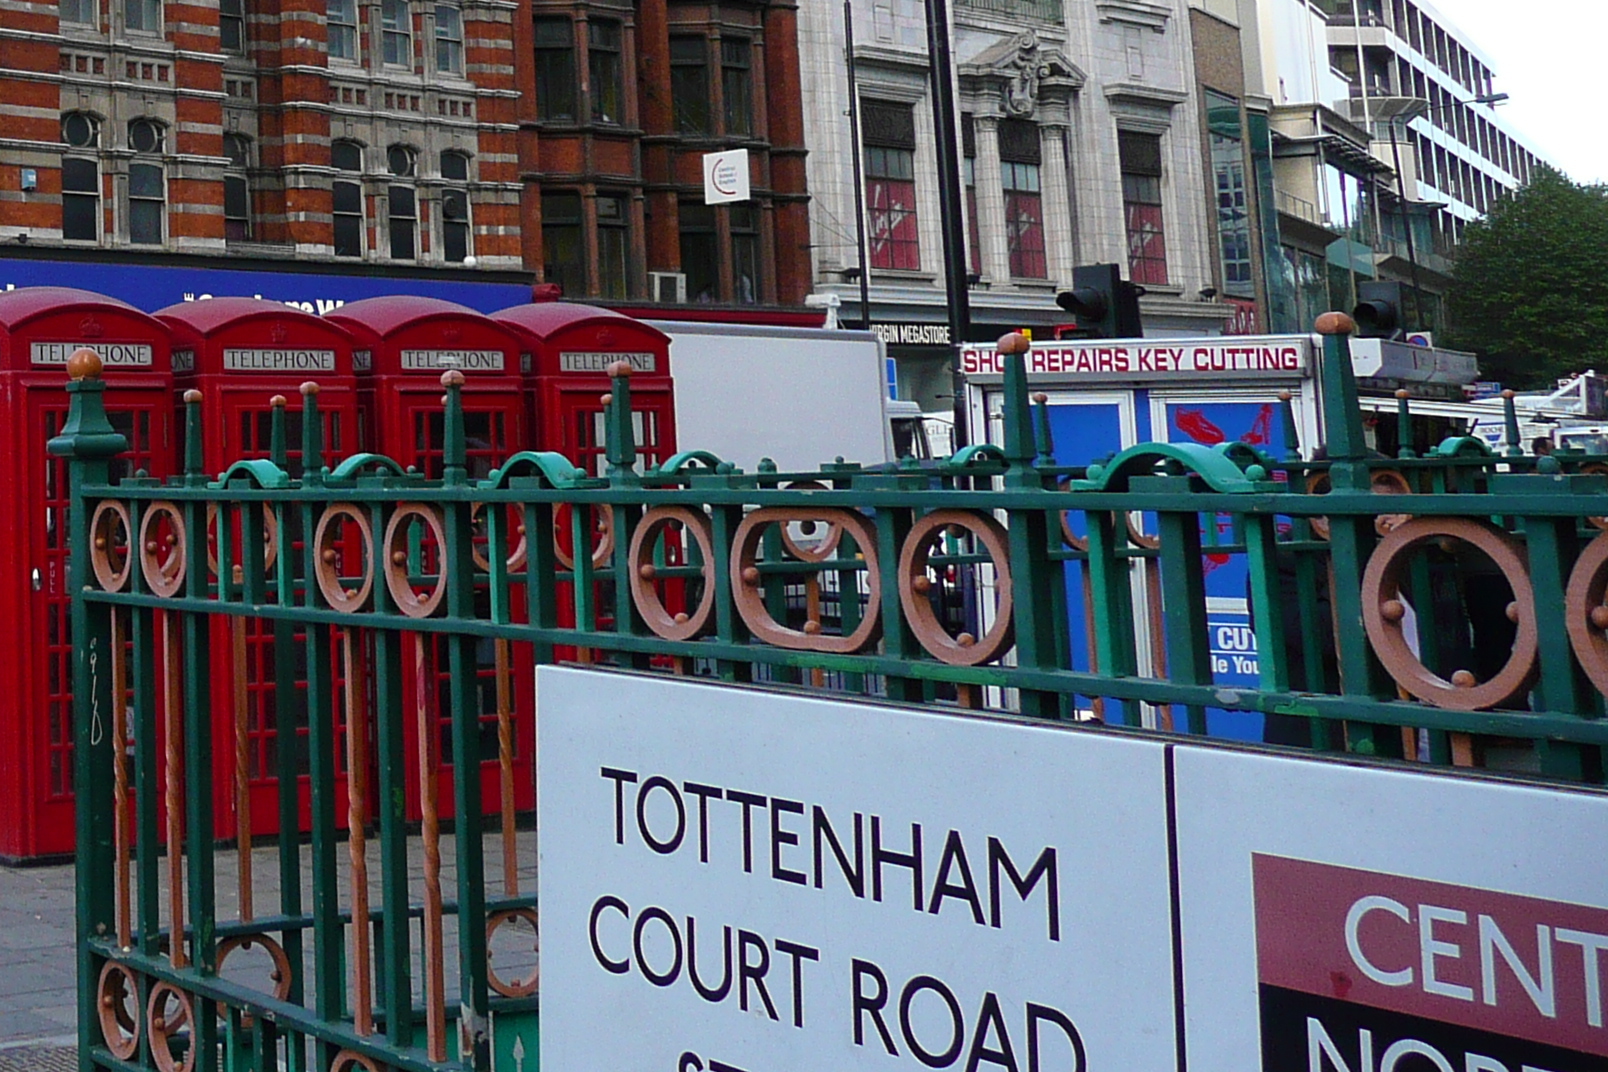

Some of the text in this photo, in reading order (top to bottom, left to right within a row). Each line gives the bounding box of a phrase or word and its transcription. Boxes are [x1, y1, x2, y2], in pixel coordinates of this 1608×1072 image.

[900, 325, 951, 344] MEGASTORE
[36, 343, 148, 364] TELHONE
[228, 349, 332, 370] TELEPHONE
[963, 347, 1299, 373] SHO REPAIRS KEY CUTTING
[1211, 656, 1228, 674] le
[600, 766, 1060, 942] TOTTENHAM
[588, 894, 1087, 1072] COURT ROAD
